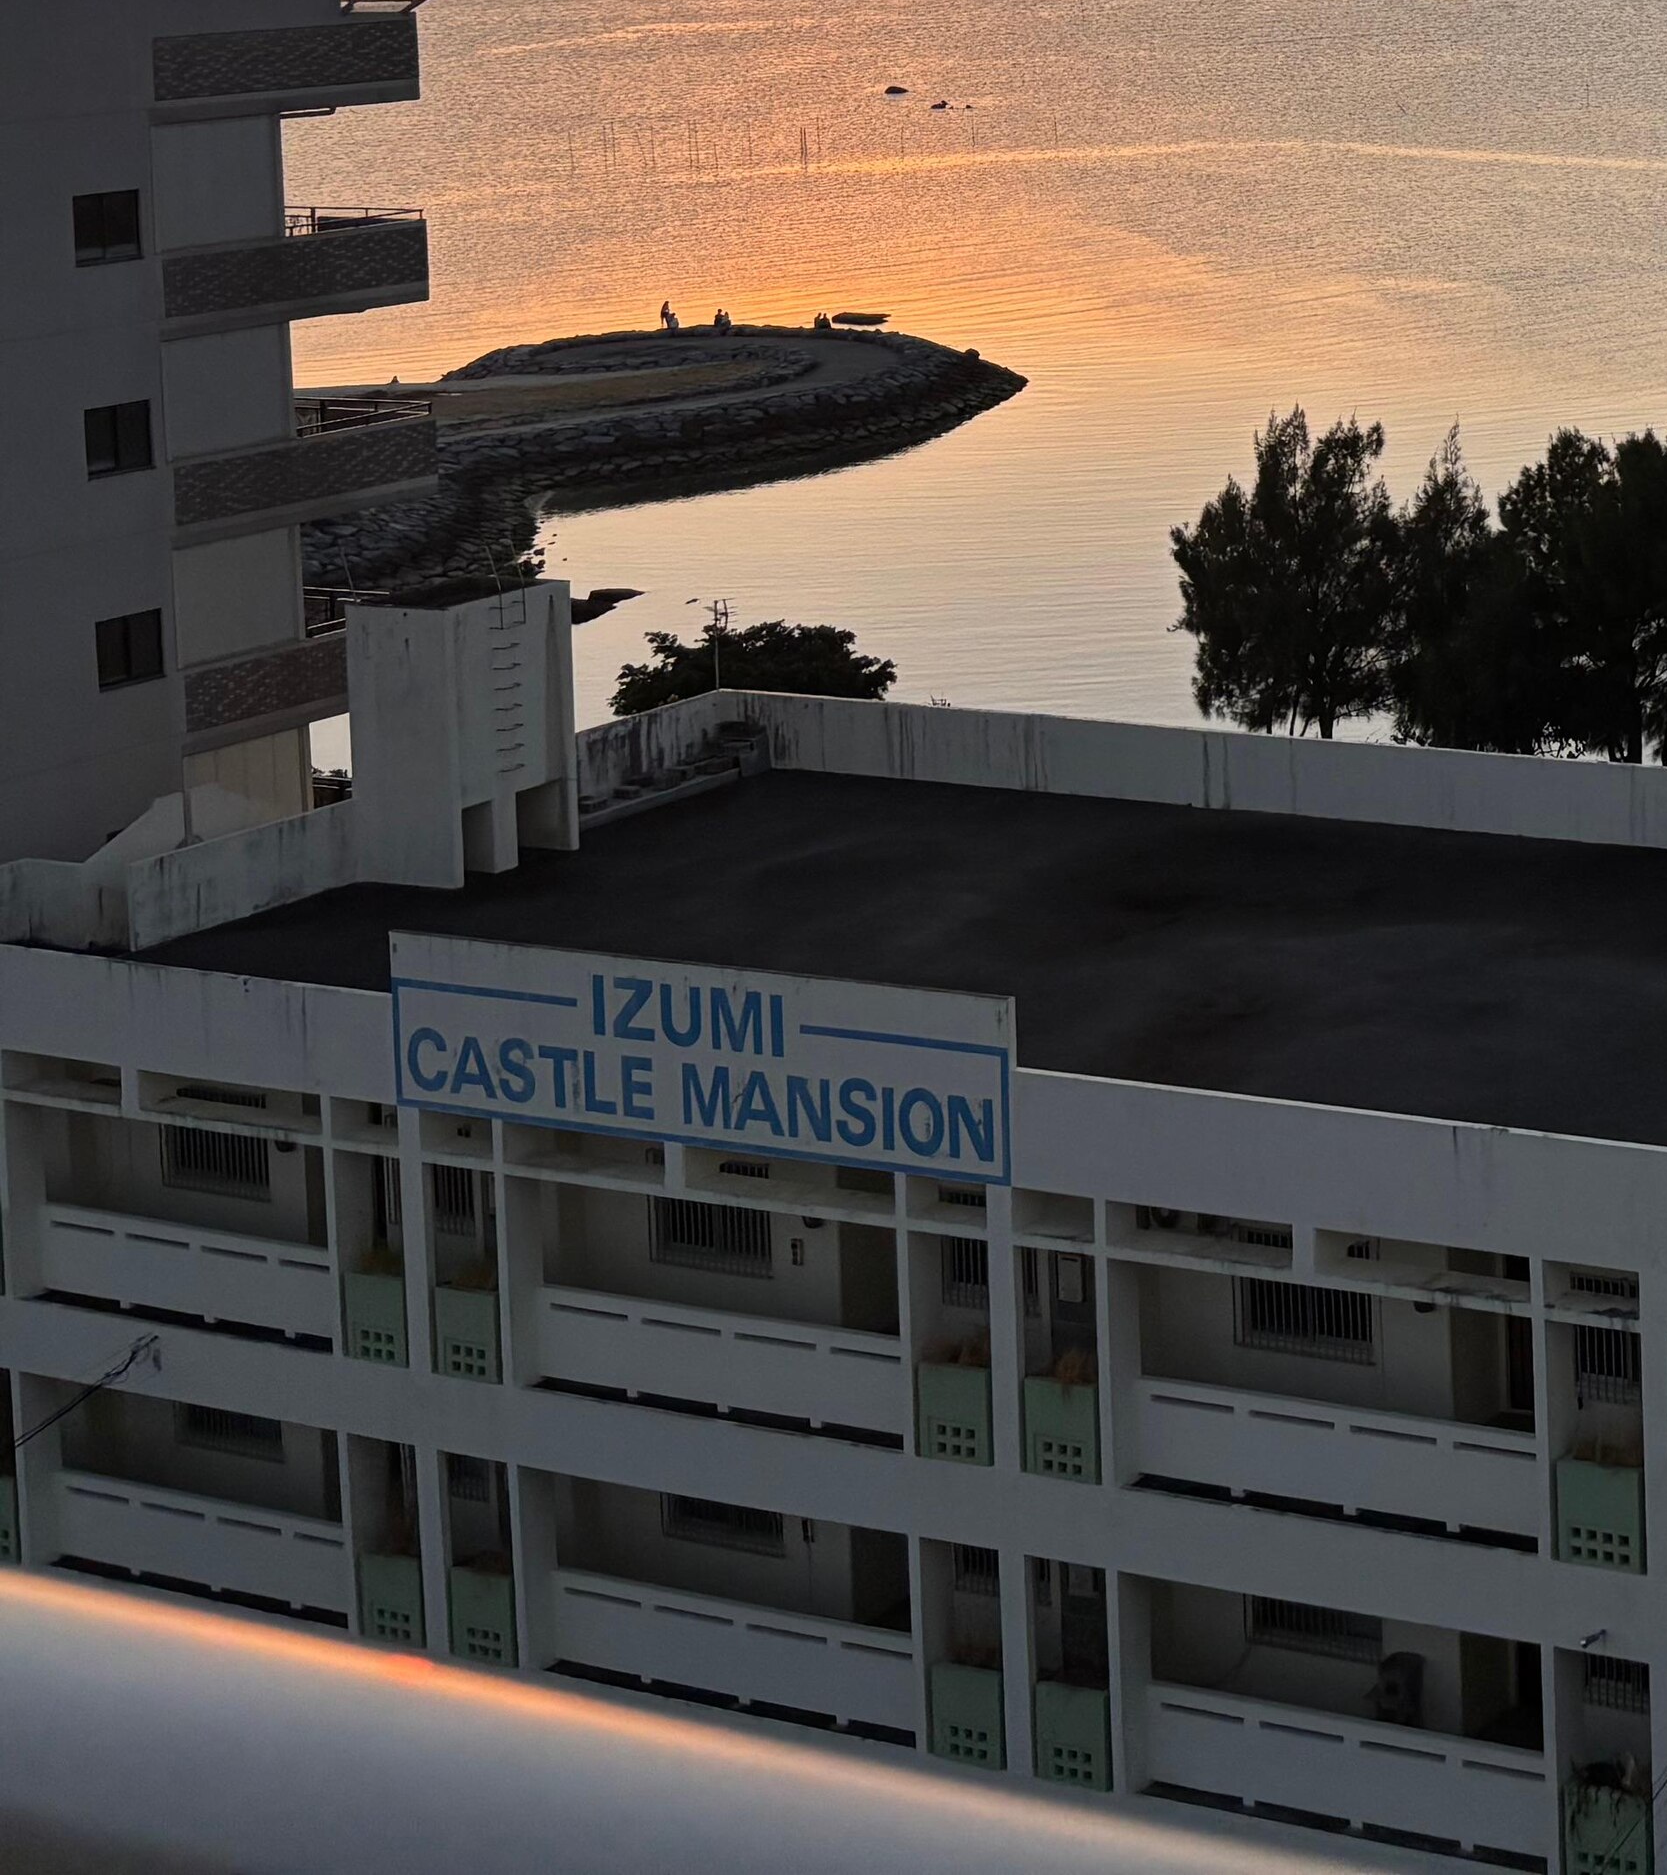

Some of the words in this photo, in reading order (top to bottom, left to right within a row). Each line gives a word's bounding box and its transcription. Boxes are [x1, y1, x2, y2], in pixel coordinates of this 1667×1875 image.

[593, 974, 785, 1057] IZUMI
[407, 1028, 655, 1120] CASTLE
[682, 1063, 994, 1162] MANSION
